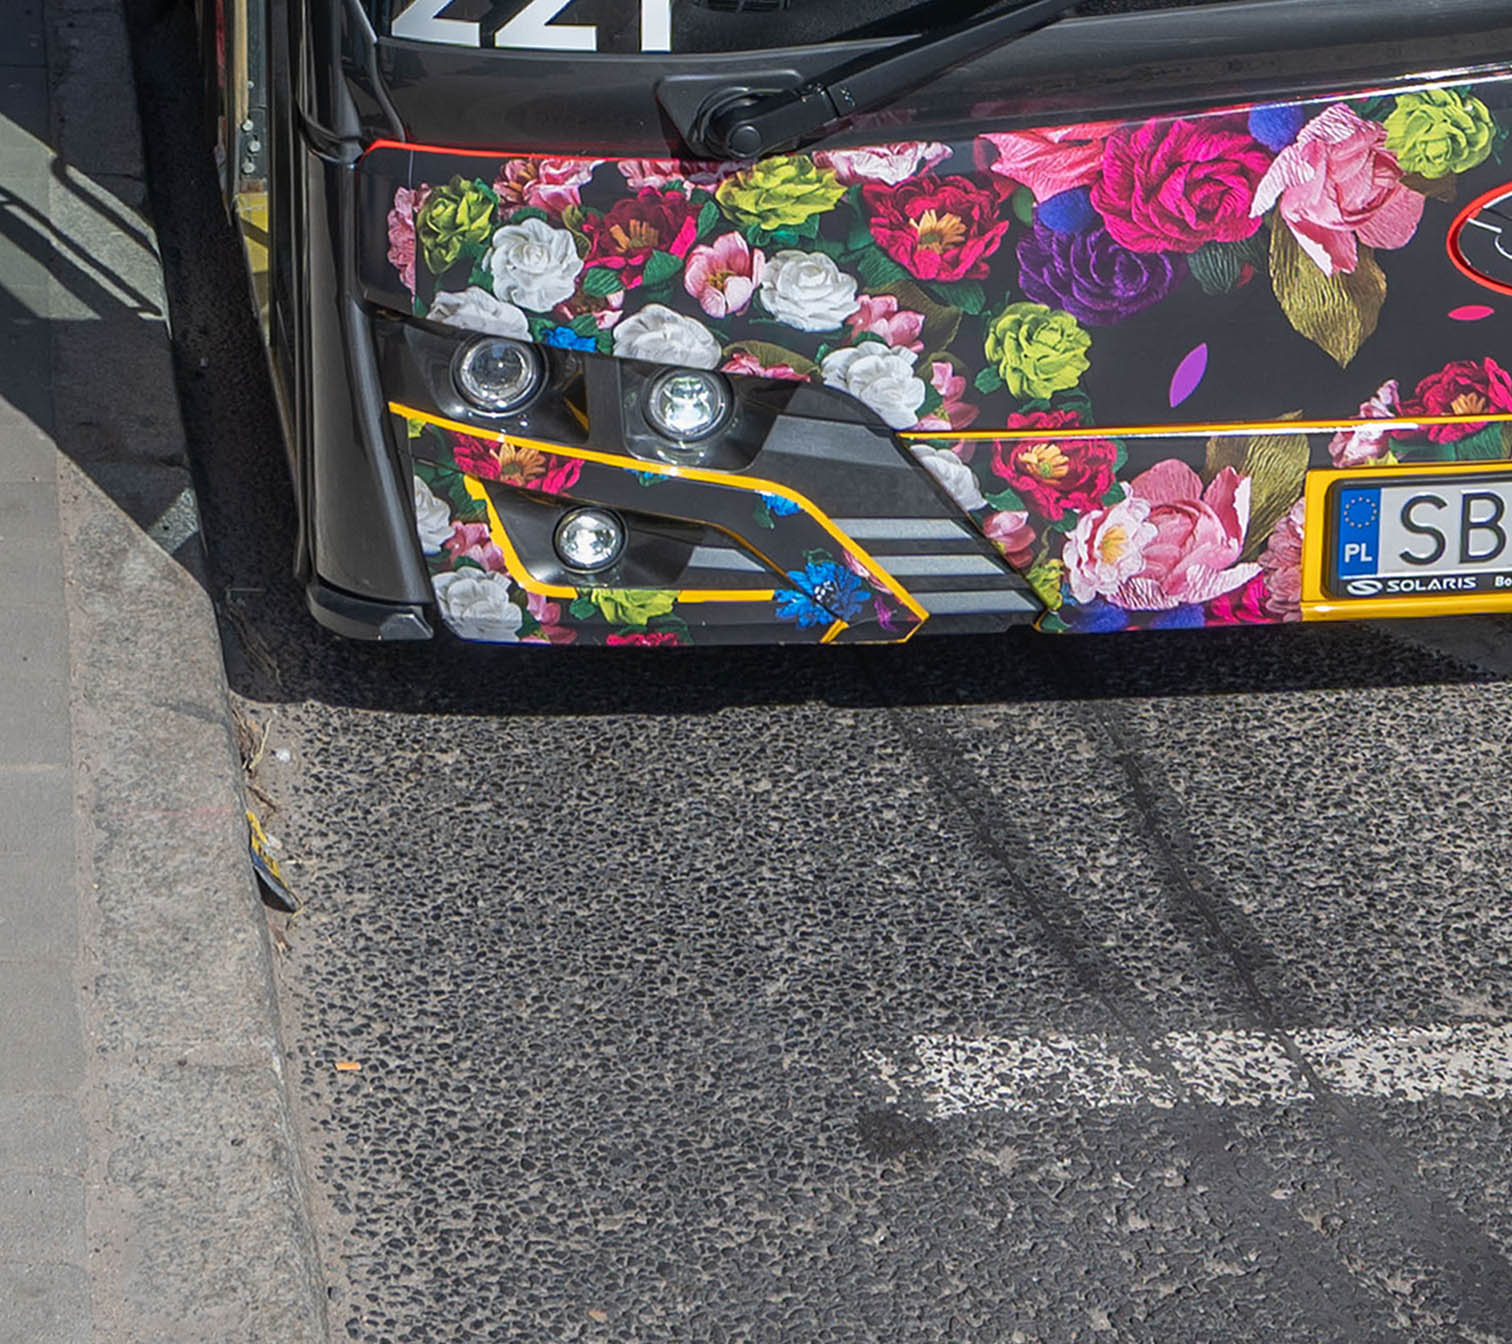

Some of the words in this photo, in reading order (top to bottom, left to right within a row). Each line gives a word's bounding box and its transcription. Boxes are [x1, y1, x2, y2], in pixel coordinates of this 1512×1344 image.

[1398, 490, 1507, 565] SB
[1343, 543, 1373, 562] PL
[1386, 576, 1477, 592] SOLARIS
